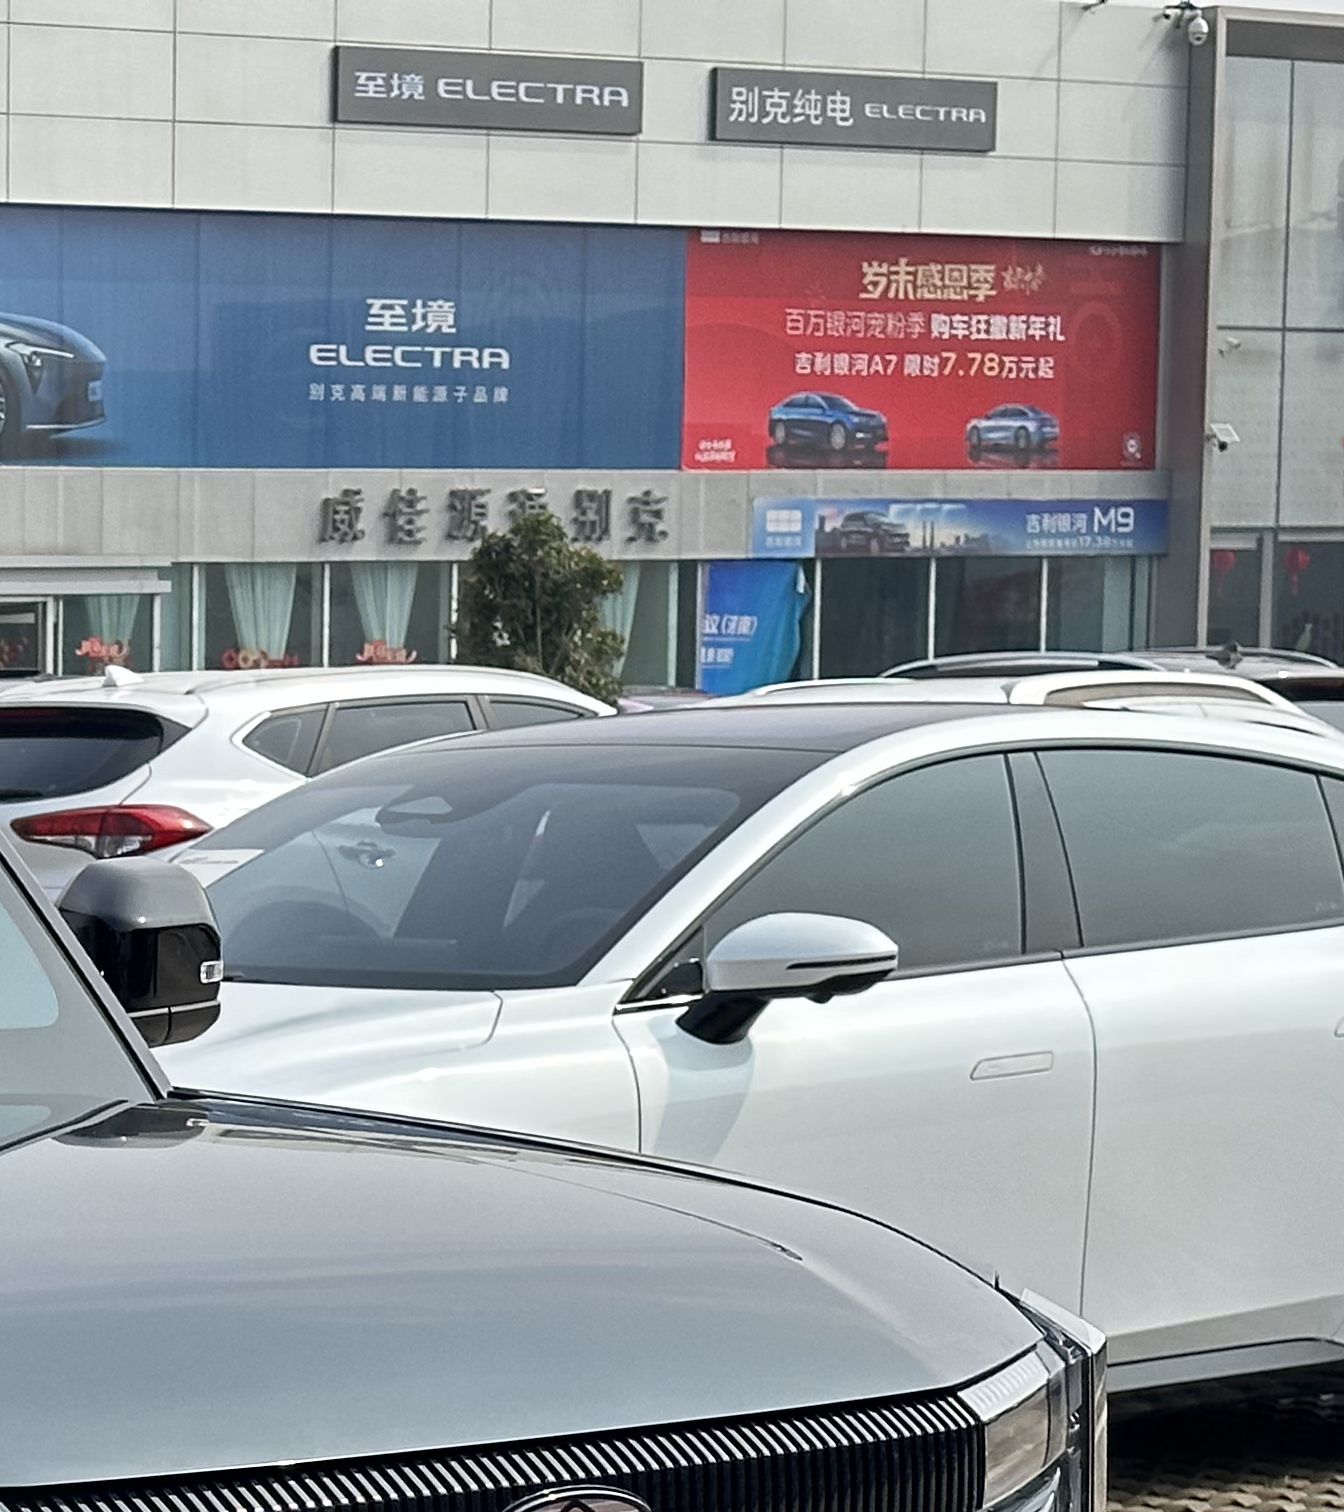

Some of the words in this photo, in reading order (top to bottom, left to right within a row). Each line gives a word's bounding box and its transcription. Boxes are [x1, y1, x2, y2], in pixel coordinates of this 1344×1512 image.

[354, 71, 426, 101] 至境
[436, 77, 629, 107] ELECTRA
[728, 86, 855, 126] 别克纯电
[863, 102, 987, 122] ELECTRA
[858, 259, 998, 302] 岁末感恩季
[364, 298, 457, 333] 至境
[784, 308, 926, 339] 百万银河宠粉季
[309, 344, 510, 370] ELECTRA
[795, 352, 898, 376] 吉利银河A7
[903, 351, 1055, 379] 限时7.78万元起
[308, 382, 509, 403] 别克高端新能源子品牌
[1093, 506, 1135, 534] M9
